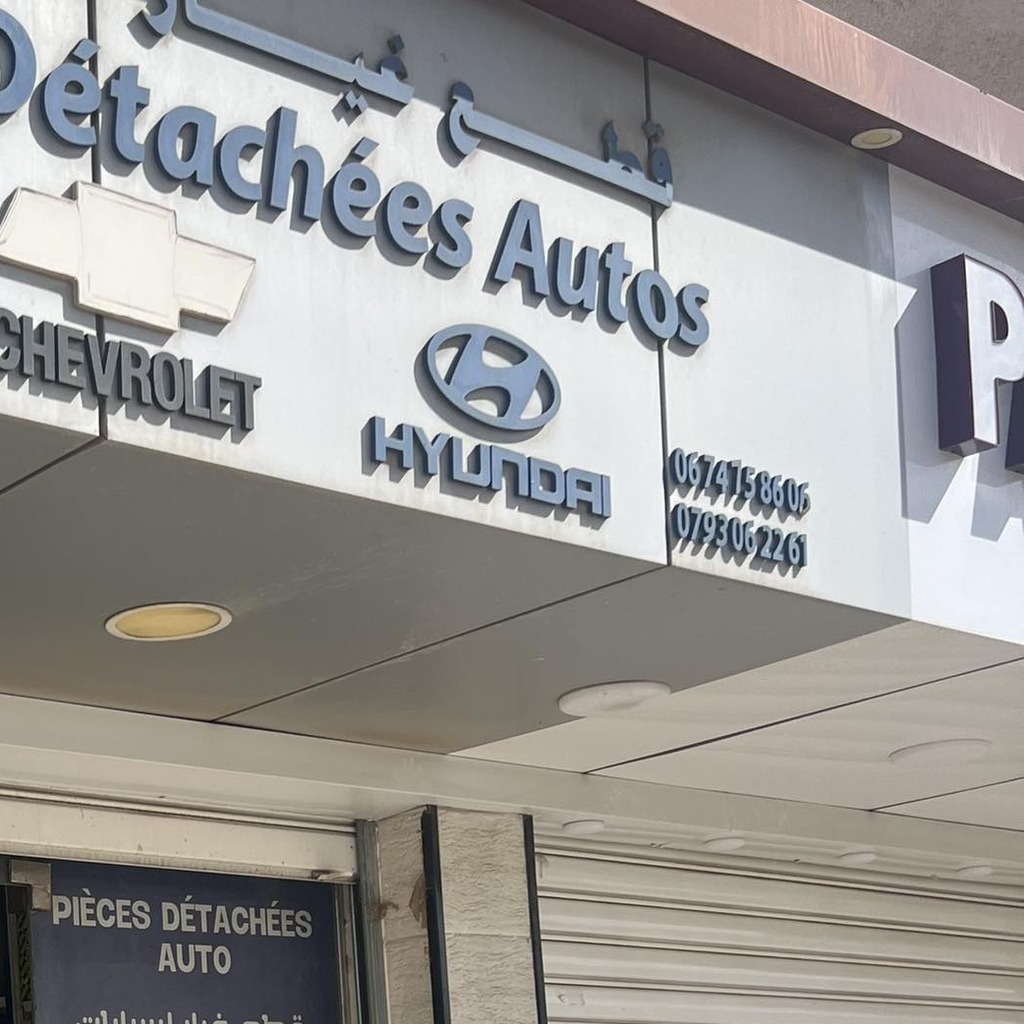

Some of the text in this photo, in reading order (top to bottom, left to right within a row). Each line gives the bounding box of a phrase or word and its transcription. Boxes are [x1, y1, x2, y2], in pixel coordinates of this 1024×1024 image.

[494, 198, 710, 346] Autos
[372, 415, 612, 517] HYUNDAI
[51, 888, 314, 938] PIÈCES DÉTACHÉES
[158, 943, 232, 975] AUTO
